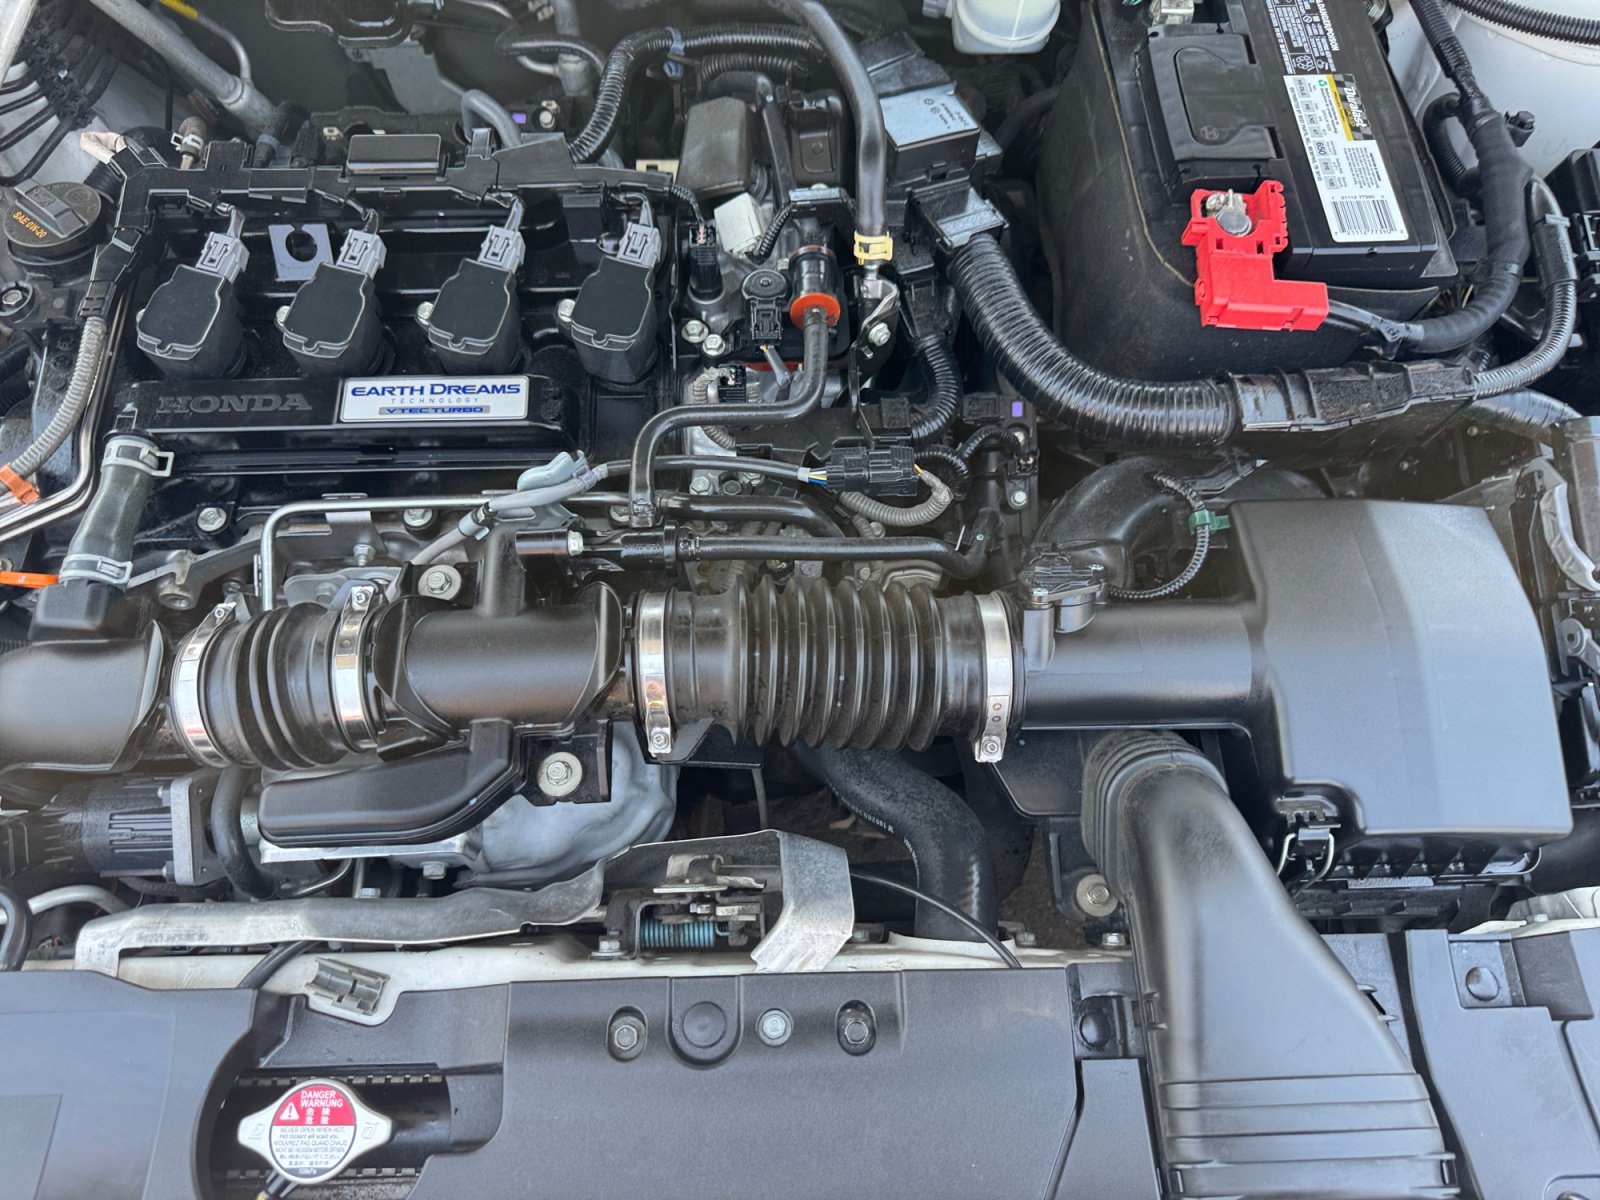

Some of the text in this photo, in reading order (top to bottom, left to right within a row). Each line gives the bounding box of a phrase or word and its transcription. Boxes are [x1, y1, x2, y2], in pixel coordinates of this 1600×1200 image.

[1342, 86, 1367, 128] Duralast
[1315, 142, 1327, 155] 650
[13, 211, 48, 238] SAE 0W-20
[351, 383, 521, 396] EARTH DREAMS
[156, 394, 313, 413] HONDA
[301, 1090, 336, 1099] DANGER
[300, 1099, 343, 1107] WARNUNG
